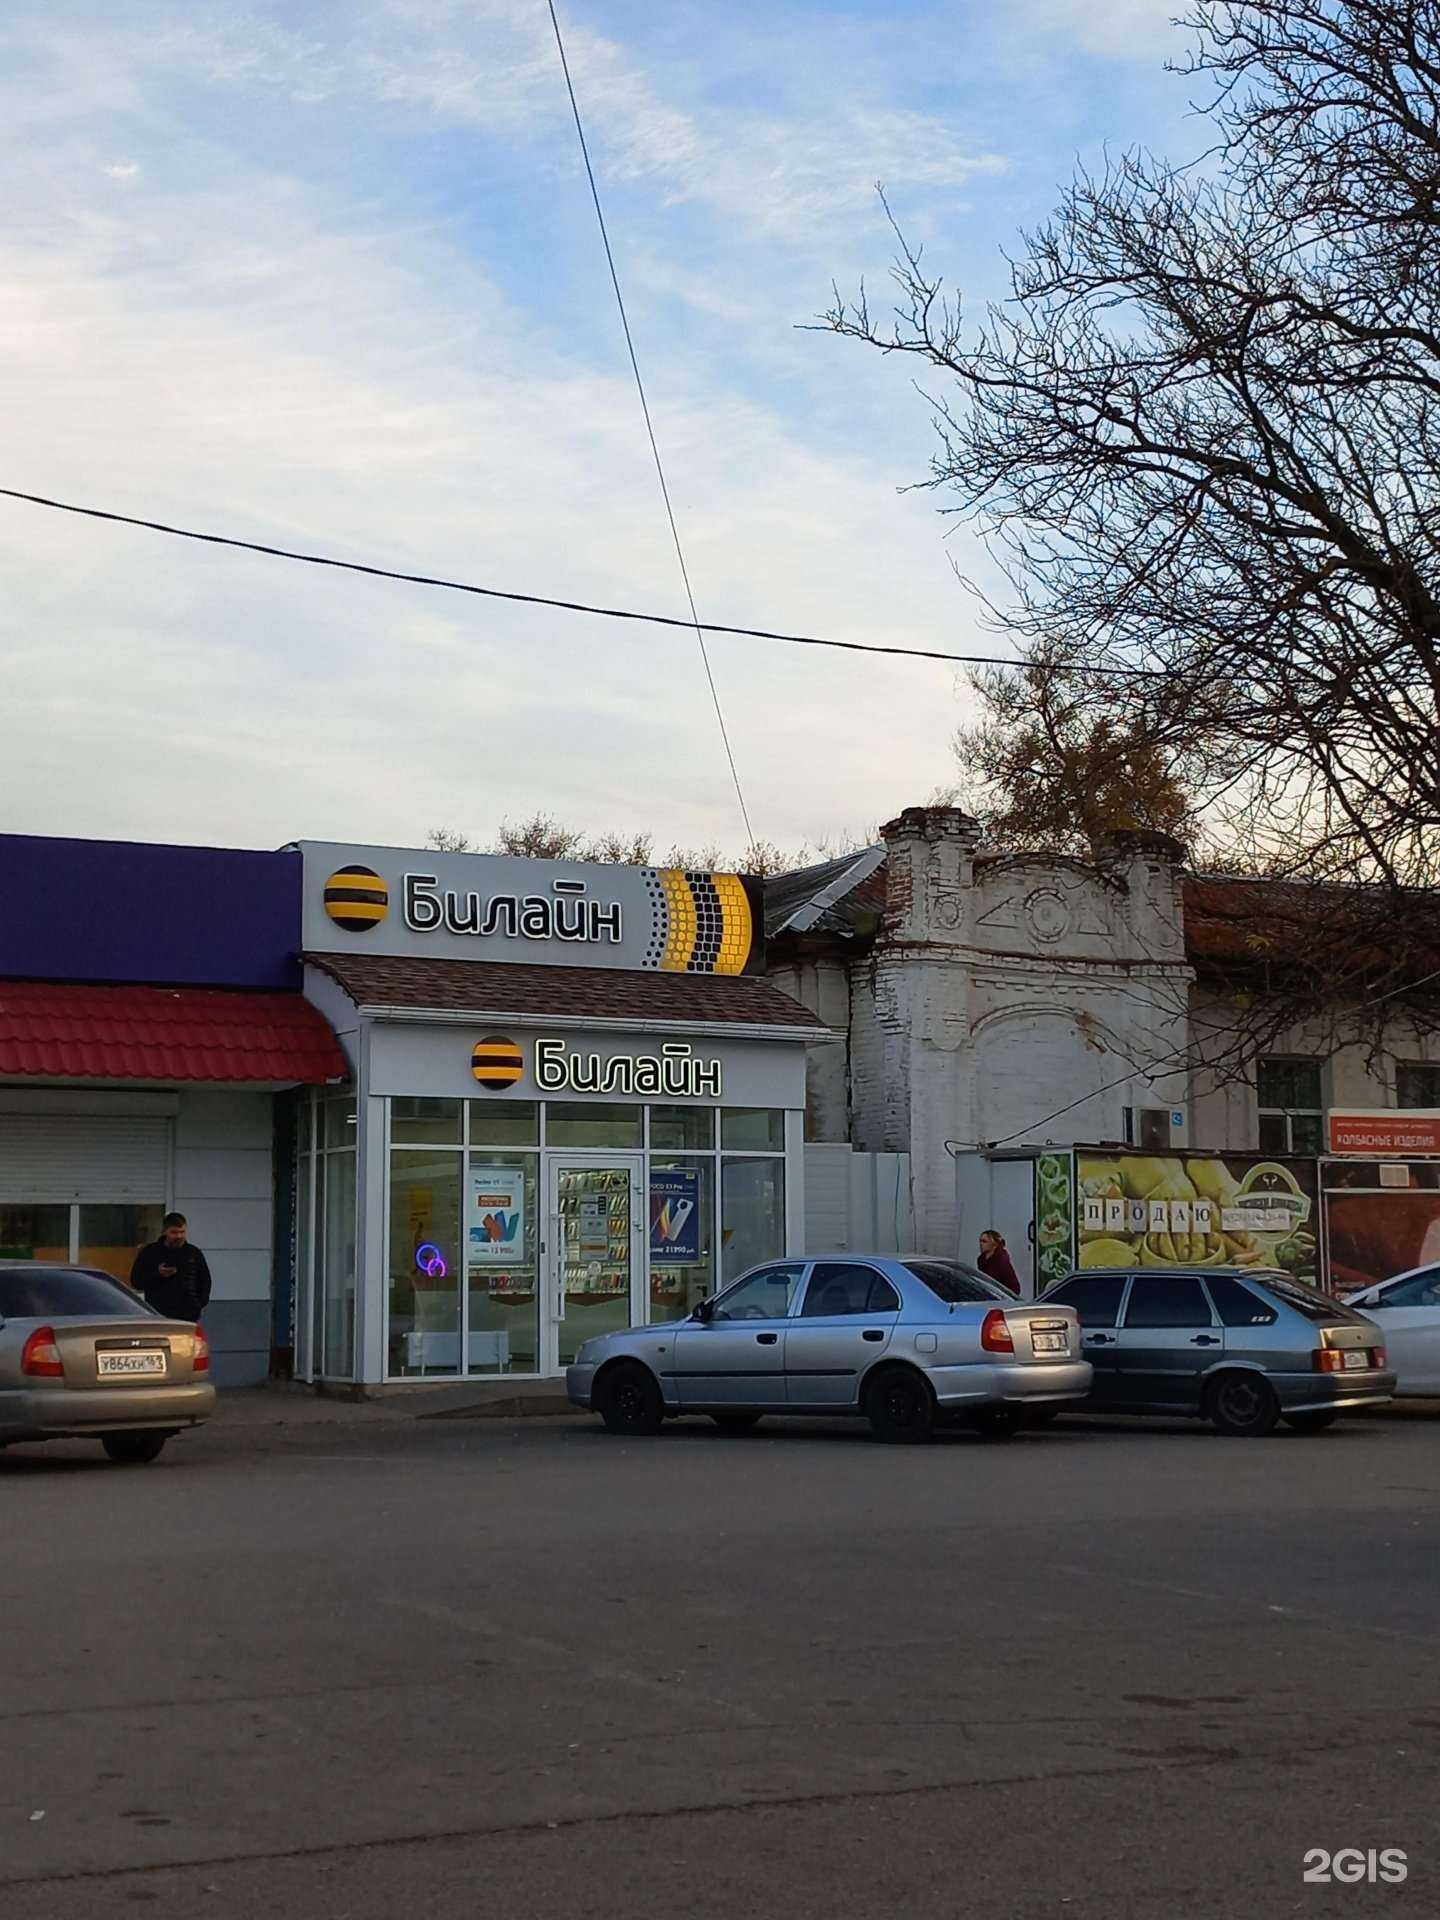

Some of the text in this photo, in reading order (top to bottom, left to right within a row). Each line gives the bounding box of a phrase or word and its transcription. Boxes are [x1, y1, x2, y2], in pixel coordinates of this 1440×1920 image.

[403, 873, 623, 943] Билайн
[534, 1039, 722, 1096] Билайн
[1088, 1204, 1211, 1224] ПРОДАЮ
